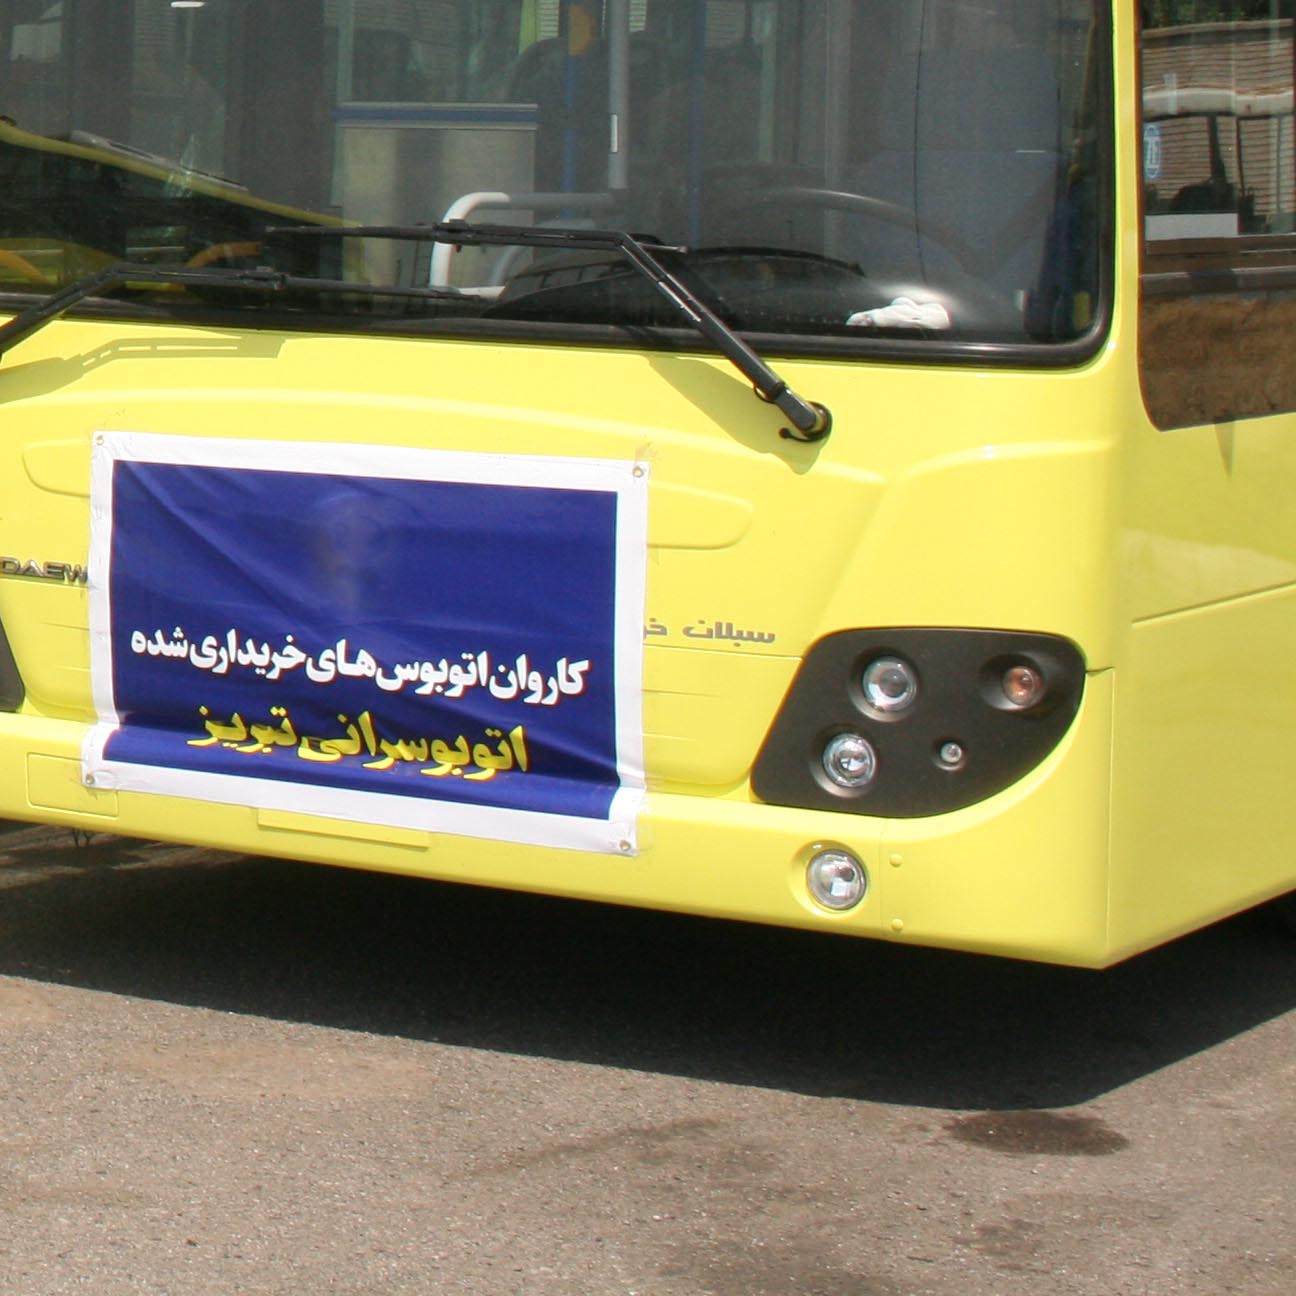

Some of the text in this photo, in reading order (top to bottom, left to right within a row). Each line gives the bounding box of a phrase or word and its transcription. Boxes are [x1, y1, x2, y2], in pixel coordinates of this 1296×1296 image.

[130, 626, 189, 658] شده
[189, 628, 307, 680] خریداری
[682, 619, 776, 648] سبلان
[488, 653, 590, 706] کاروان
[186, 704, 298, 754] تبریز
